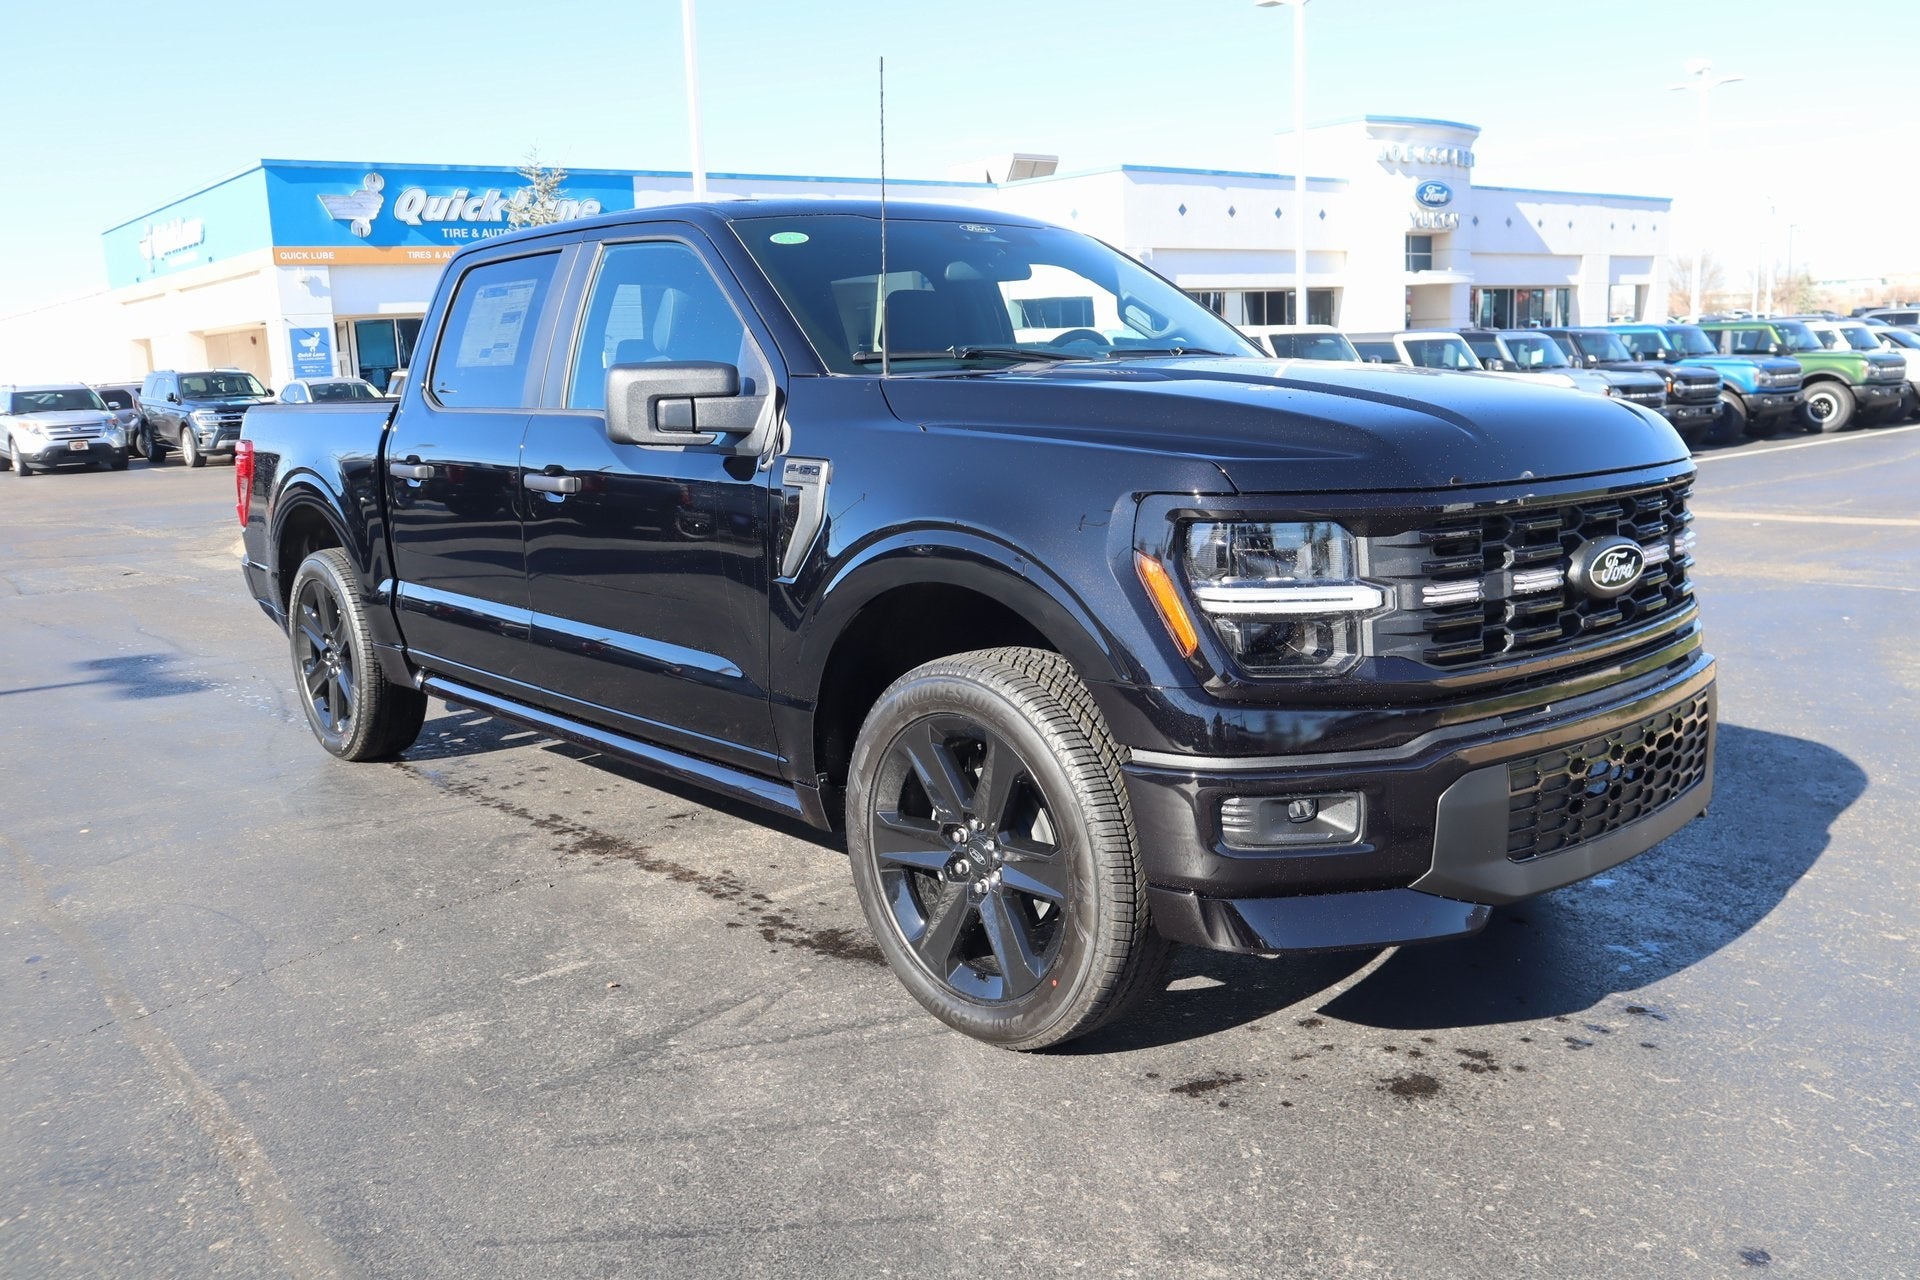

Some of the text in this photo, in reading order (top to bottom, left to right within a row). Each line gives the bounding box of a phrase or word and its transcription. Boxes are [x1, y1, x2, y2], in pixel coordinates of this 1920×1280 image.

[1422, 185, 1448, 202] Ford
[394, 187, 505, 225] Quick
[441, 227, 469, 239] TIRE
[471, 228, 480, 238] &
[279, 251, 335, 260] QUICK LUBE
[407, 251, 432, 259] TIRES
[434, 251, 441, 259] &
[785, 463, 821, 476] F-150
[1601, 551, 1636, 584] Ford
